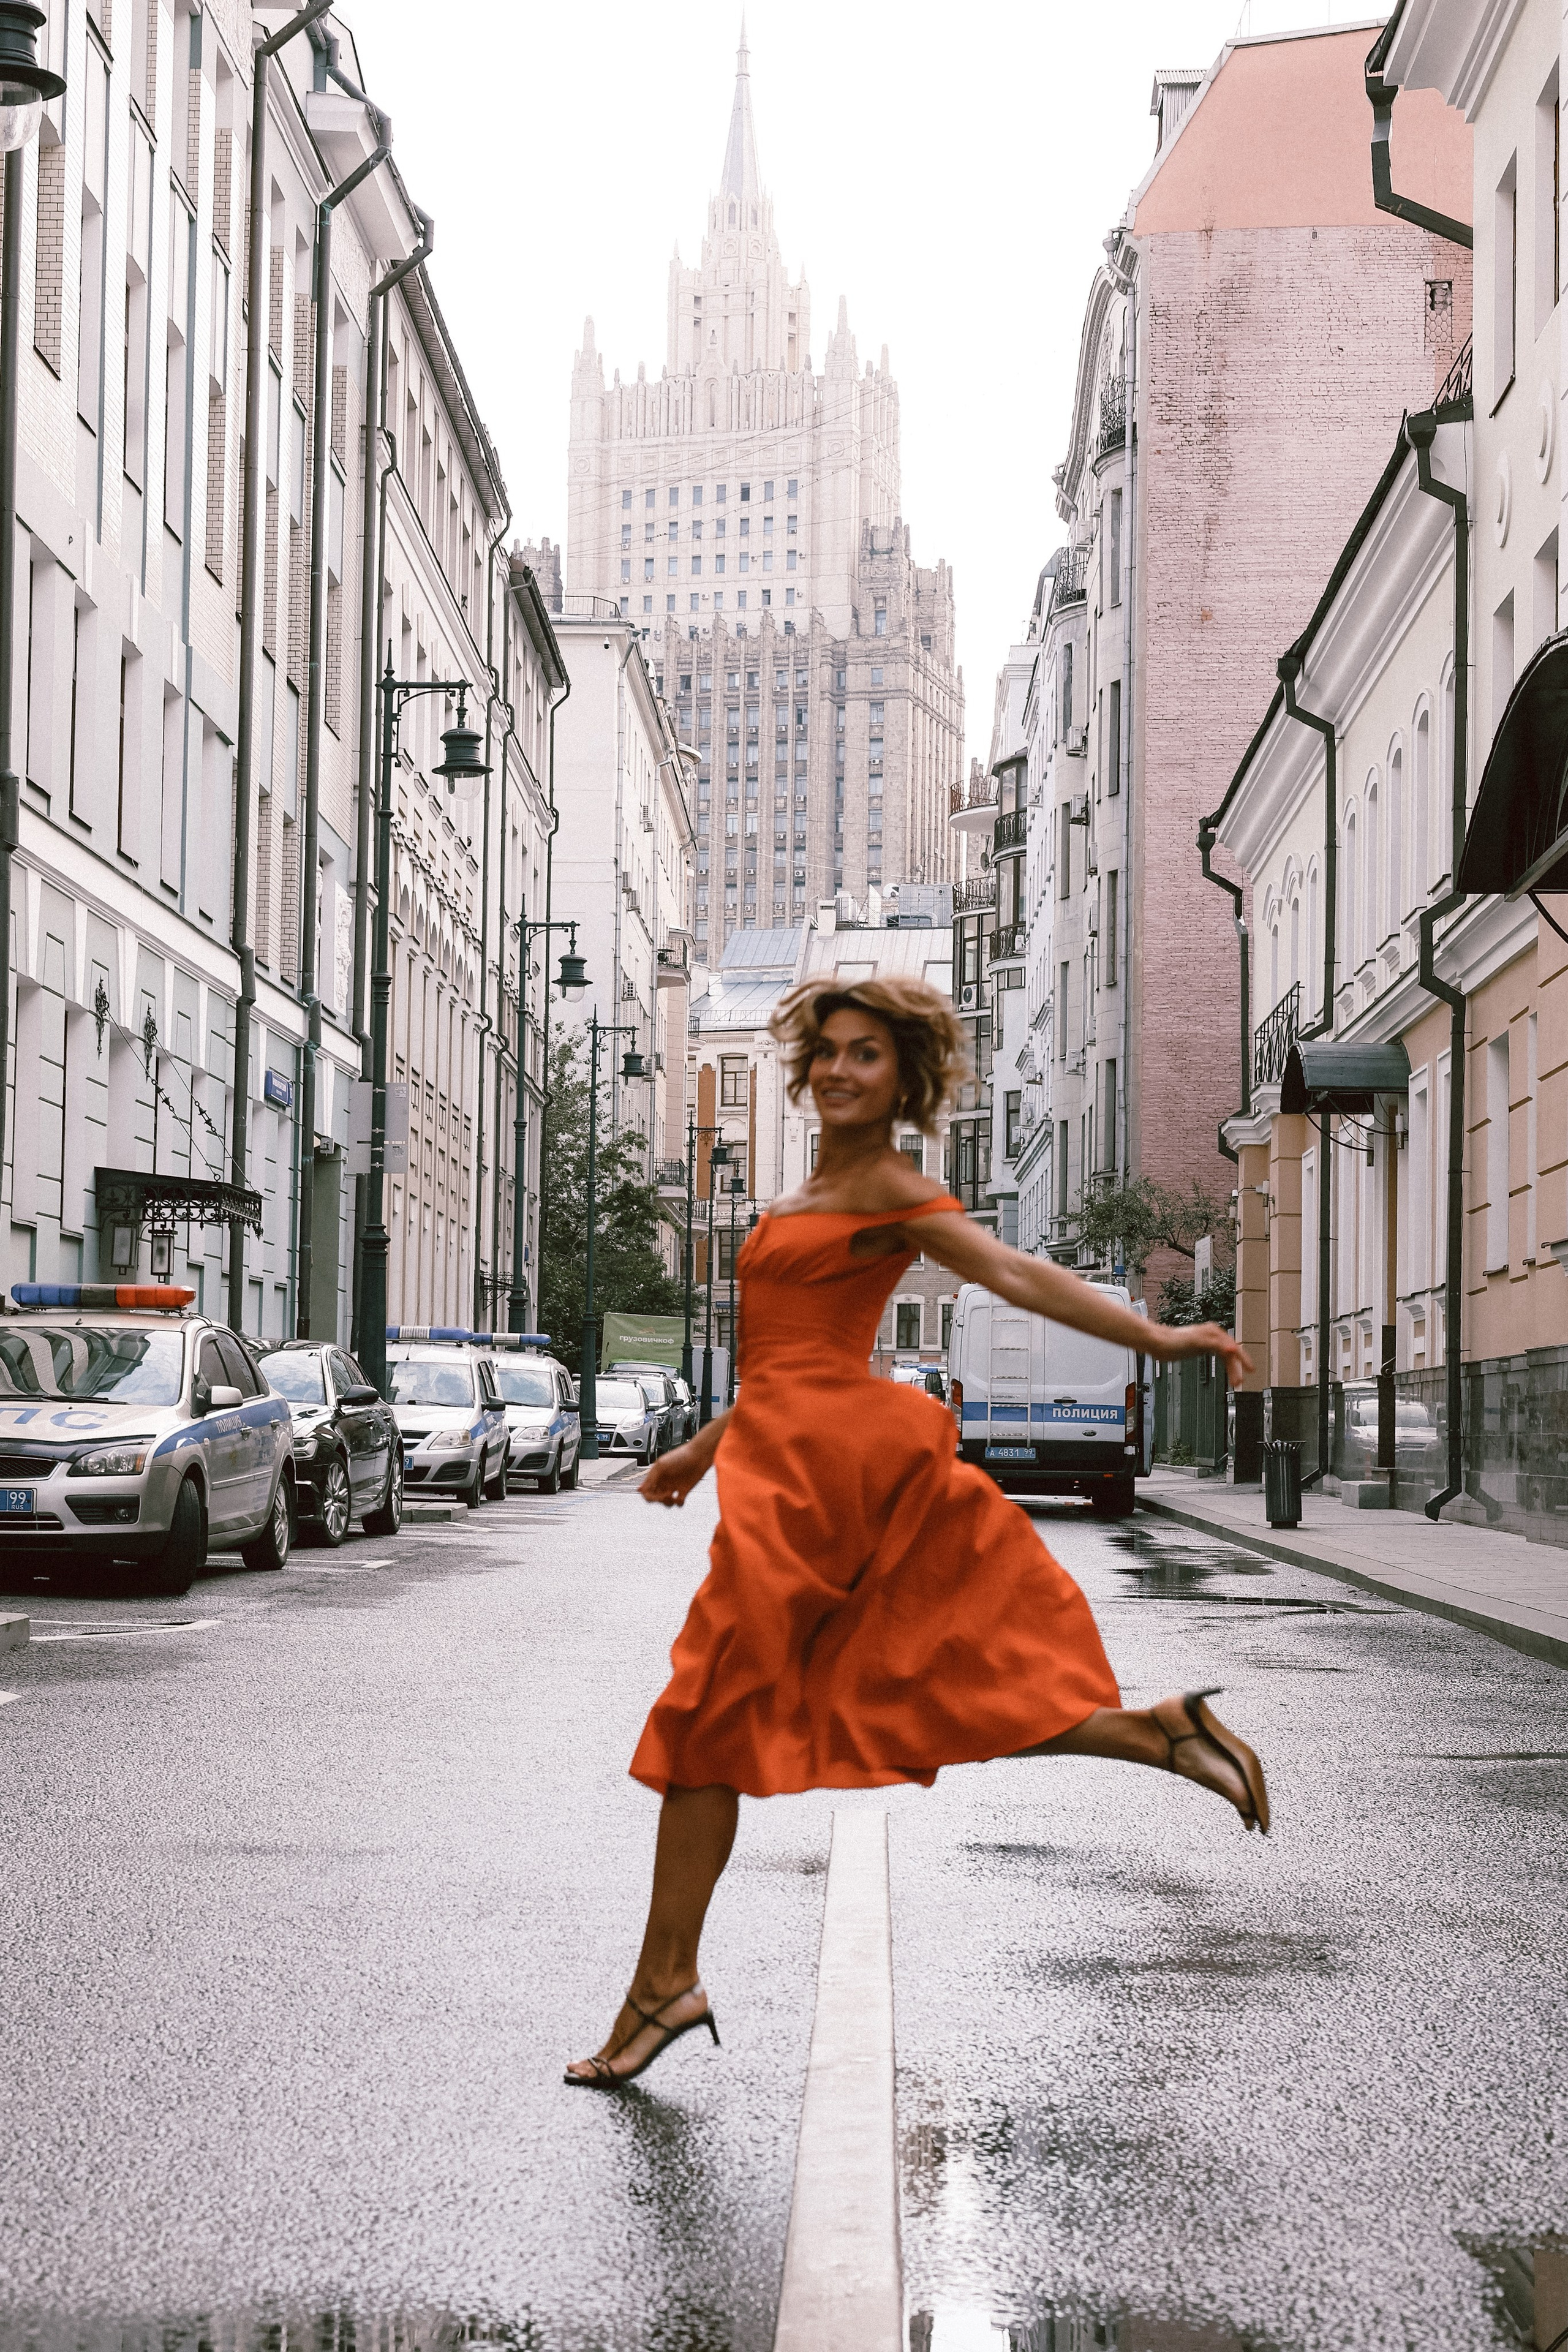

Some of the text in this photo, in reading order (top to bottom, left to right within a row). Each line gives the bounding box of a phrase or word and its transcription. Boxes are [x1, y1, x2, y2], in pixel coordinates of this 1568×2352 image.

[619, 1335, 674, 1344] грузовичкоф
[1052, 1408, 1118, 1420] ПОЛИЦИЯ
[216, 1415, 243, 1433] ПОЛИЦИЯ
[9, 1491, 26, 1504] 99
